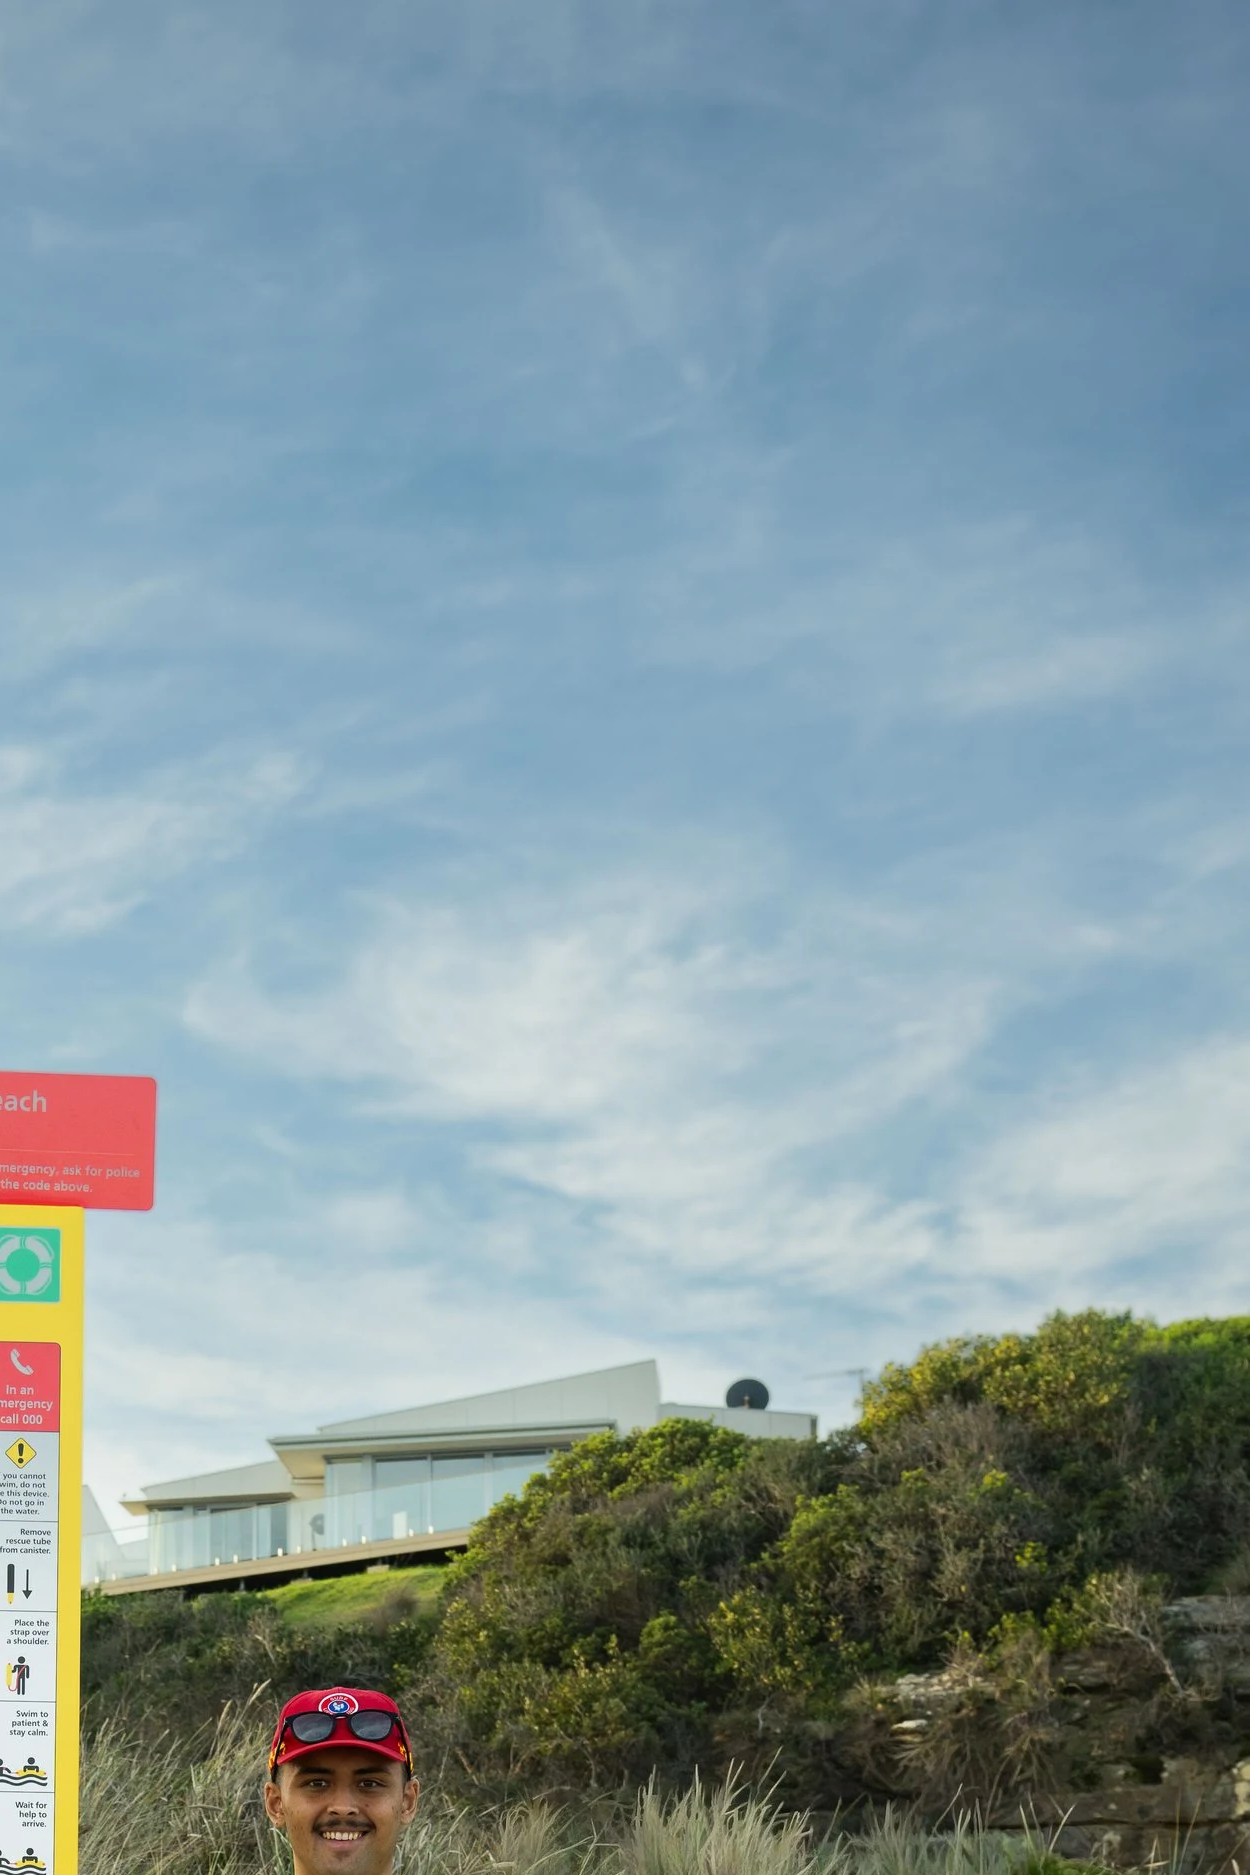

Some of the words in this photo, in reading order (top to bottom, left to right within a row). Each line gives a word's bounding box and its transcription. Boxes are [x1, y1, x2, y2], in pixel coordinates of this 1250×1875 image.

[63, 1164, 82, 1176] ask
[85, 1165, 103, 1177] for
[106, 1166, 141, 1179] police
[0, 1178, 20, 1190] the
[23, 1179, 51, 1191] code
[54, 1180, 93, 1193] above.
[5, 1384, 17, 1395] In
[20, 1386, 34, 1395] an
[0, 1413, 19, 1425] call
[22, 1414, 43, 1425] 000
[20, 1481, 31, 1489] do
[23, 1490, 50, 1498] device.
[24, 1500, 35, 1508] go
[0, 1507, 14, 1515] the
[15, 1508, 40, 1516] water.
[20, 1528, 52, 1536] Remove
[33, 1537, 52, 1545] tube
[0, 1546, 18, 1554] from
[19, 1546, 51, 1555] canister.
[14, 1619, 35, 1627] Place
[36, 1619, 50, 1627] the
[10, 1629, 31, 1637] strap
[13, 1637, 50, 1645] shoulder.
[16, 1710, 38, 1718] Swim
[11, 1720, 41, 1728] patient
[9, 1729, 26, 1737] stay
[27, 1728, 49, 1737] calm.
[15, 1801, 34, 1809] Wait
[35, 1801, 48, 1809] for
[19, 1811, 37, 1819] help
[22, 1820, 47, 1828] arrive.
